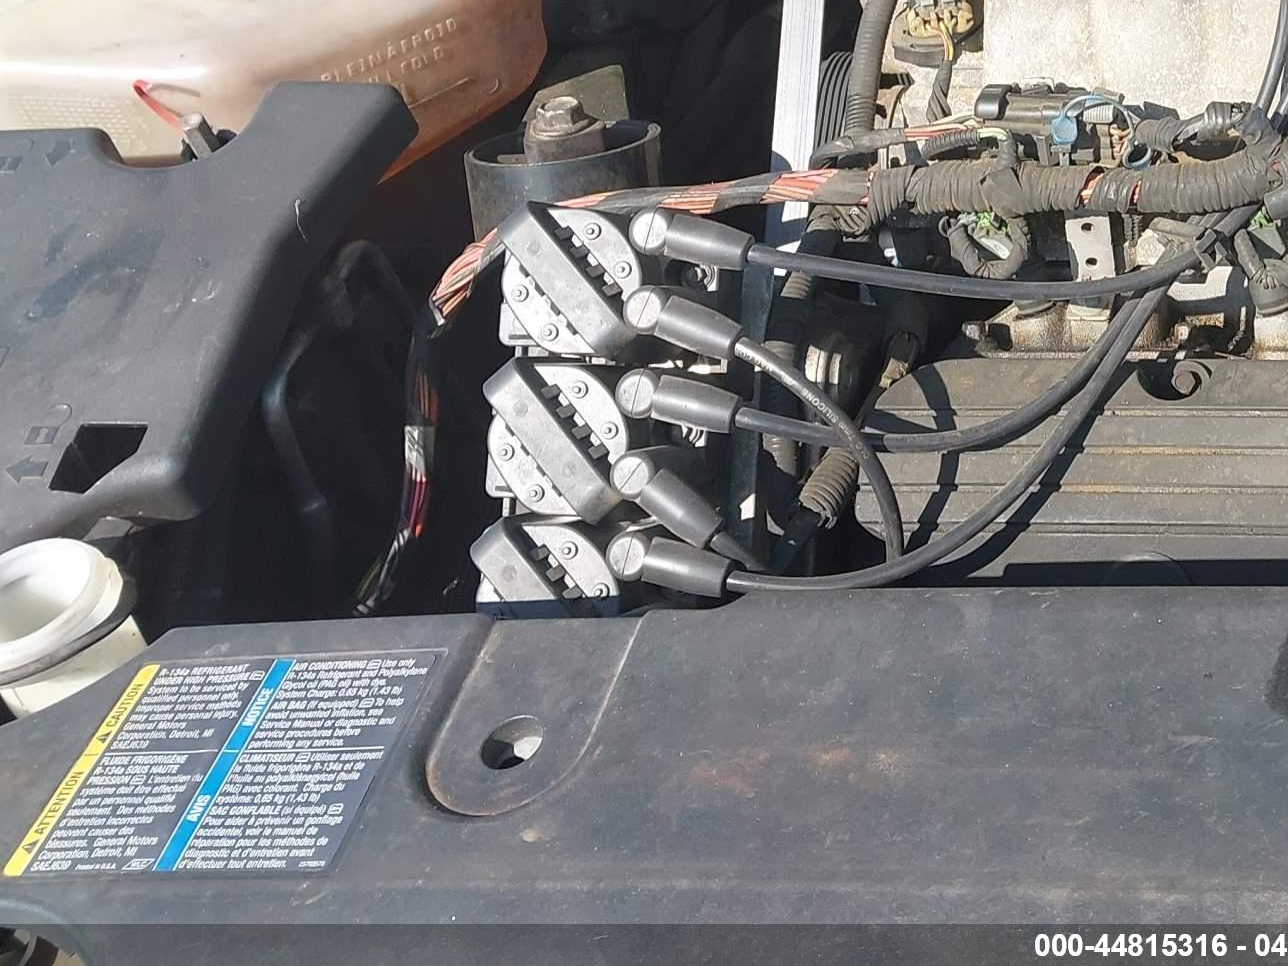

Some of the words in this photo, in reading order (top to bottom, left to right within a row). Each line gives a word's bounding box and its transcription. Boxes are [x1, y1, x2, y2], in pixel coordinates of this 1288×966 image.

[799, 388, 839, 423] SILICONE
[294, 662, 308, 670] AIR
[309, 660, 367, 669] CONDITIONING
[398, 658, 415, 667] only
[159, 667, 190, 675] R-134a
[191, 664, 249, 674] REFRIGERANT
[288, 671, 316, 679] R-134a
[317, 670, 361, 679] Refrigerant
[378, 667, 427, 677] Polyalkylene
[206, 672, 250, 682] PRESSURE
[147, 686, 179, 695] System
[202, 683, 237, 691] serviced
[281, 681, 306, 690] Glycol
[318, 680, 337, 688] (PAG
[338, 679, 351, 687] oil)
[371, 678, 387, 686] dye.
[141, 694, 178, 703] qualified
[179, 693, 220, 701] personnel
[276, 690, 306, 699] System
[307, 689, 338, 698] Charge:
[357, 688, 368, 696] kg
[107, 683, 143, 727] CAUTION
[135, 704, 173, 712] Improper
[174, 702, 205, 710] service
[207, 700, 242, 708] methods
[241, 688, 273, 725] NOTICE
[317, 699, 359, 708] equipped)
[386, 697, 404, 705] help
[174, 711, 213, 720] personal
[212, 710, 240, 718] injury.
[289, 709, 330, 717] unwanted
[123, 721, 156, 729] General
[156, 721, 187, 729] Motors
[261, 720, 291, 728] Service
[293, 719, 323, 727] Manual
[334, 717, 377, 728] diagnostic
[379, 716, 395, 724] and
[169, 729, 202, 738] Detroit,
[285, 729, 332, 739] procedures
[111, 740, 149, 748] SAEJ639
[248, 739, 295, 748] performing
[131, 754, 188, 763] FRIGORIGÈNE
[240, 754, 295, 762] CLIMATISEUR
[311, 752, 339, 760] Utiliser
[341, 751, 383, 759] seulement
[94, 766, 125, 774] R-134a
[126, 765, 149, 773] SOUS
[150, 764, 179, 773] HAUTE
[313, 762, 343, 770] R-134a
[354, 761, 365, 769] de
[87, 776, 130, 784] PRESSION
[336, 772, 360, 781] (huile
[222, 784, 241, 792] PAG)
[303, 783, 333, 792] Charge
[334, 782, 345, 790] du
[34, 771, 84, 834] ATTENTION
[72, 798, 89, 807] par
[101, 796, 144, 805] personnel
[273, 794, 285, 803] kg
[308, 793, 321, 802] lb)
[67, 806, 113, 815] seulement.
[117, 805, 135, 813] Des
[185, 794, 211, 821] AVIS
[229, 806, 281, 814] GONFLABLE
[293, 805, 326, 815] équipé)
[59, 817, 106, 826] d'entretien
[106, 816, 153, 824] incorrectes
[256, 816, 292, 825] prévenir
[305, 815, 343, 825] gonflage
[52, 829, 87, 837] peuvent
[197, 827, 244, 836] accidentel,
[274, 826, 305, 834] manuel
[306, 826, 318, 834] de
[45, 840, 89, 848] blessures.
[93, 837, 126, 845] General
[127, 836, 158, 844] Motors
[190, 838, 236, 847] réparation
[236, 839, 256, 847] pour
[273, 837, 315, 845] méthodes
[317, 836, 329, 844] de
[38, 850, 91, 859] Corporation,
[91, 848, 124, 857] Detroit,
[124, 847, 137, 855] MI
[184, 849, 230, 858] diagnostic
[242, 848, 288, 856] d'entretien
[290, 848, 314, 856] avant
[30, 861, 70, 870] SAEJ639
[179, 859, 227, 867] d'effectuer
[228, 859, 246, 867] tout
[247, 859, 288, 867] entretien.
